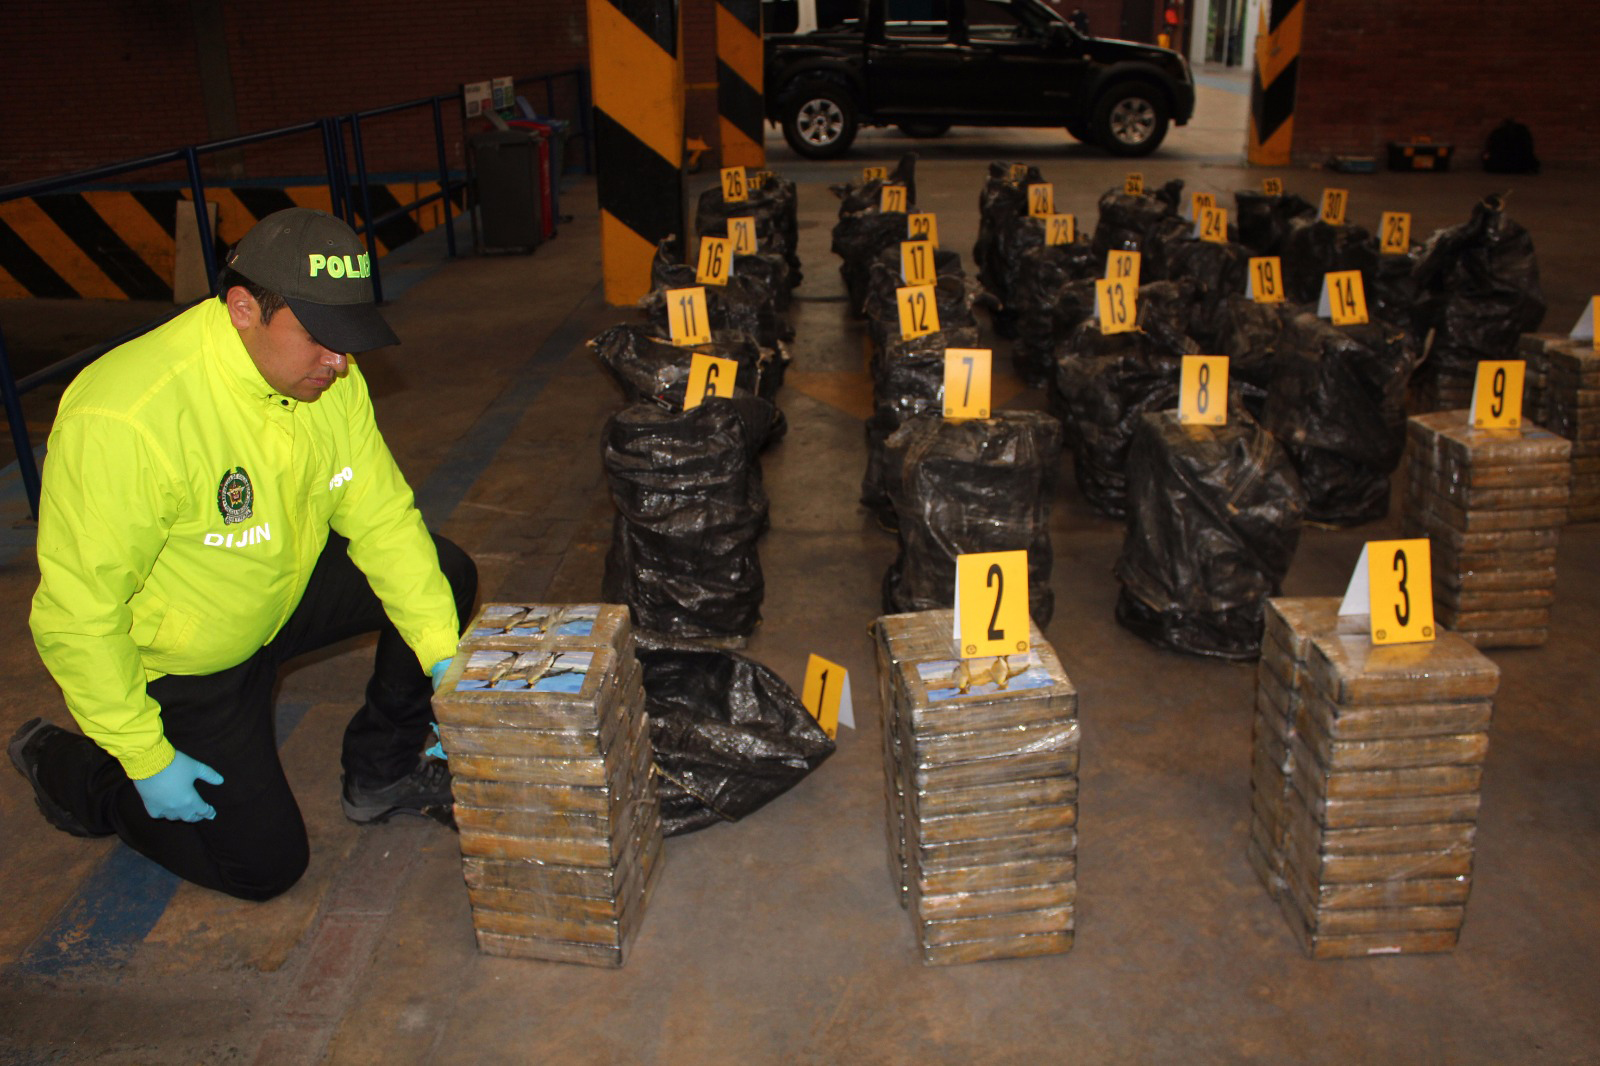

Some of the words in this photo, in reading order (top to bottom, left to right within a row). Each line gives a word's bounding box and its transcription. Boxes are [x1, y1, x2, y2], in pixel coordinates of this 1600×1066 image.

[726, 173, 741, 197] 26
[888, 190, 901, 212] 27
[1034, 189, 1049, 214] 28
[1326, 193, 1341, 219] 30
[735, 222, 749, 251] 21
[1052, 220, 1068, 244] 23
[1204, 211, 1220, 236] 24
[1387, 218, 1403, 246] 25
[707, 243, 722, 277] 16
[910, 246, 924, 279] 17
[1257, 262, 1273, 295] 19
[907, 292, 929, 332] 12
[1107, 284, 1126, 324] 13
[1335, 277, 1356, 317] 14
[679, 294, 697, 337] 11
[705, 364, 719, 400] 6
[962, 358, 975, 407] 7
[1197, 363, 1210, 414] 8
[1491, 368, 1505, 418] 9
[204, 523, 271, 548] DIJIN
[986, 564, 1005, 641] 2
[1392, 549, 1410, 626] 3
[817, 669, 829, 722] 1
